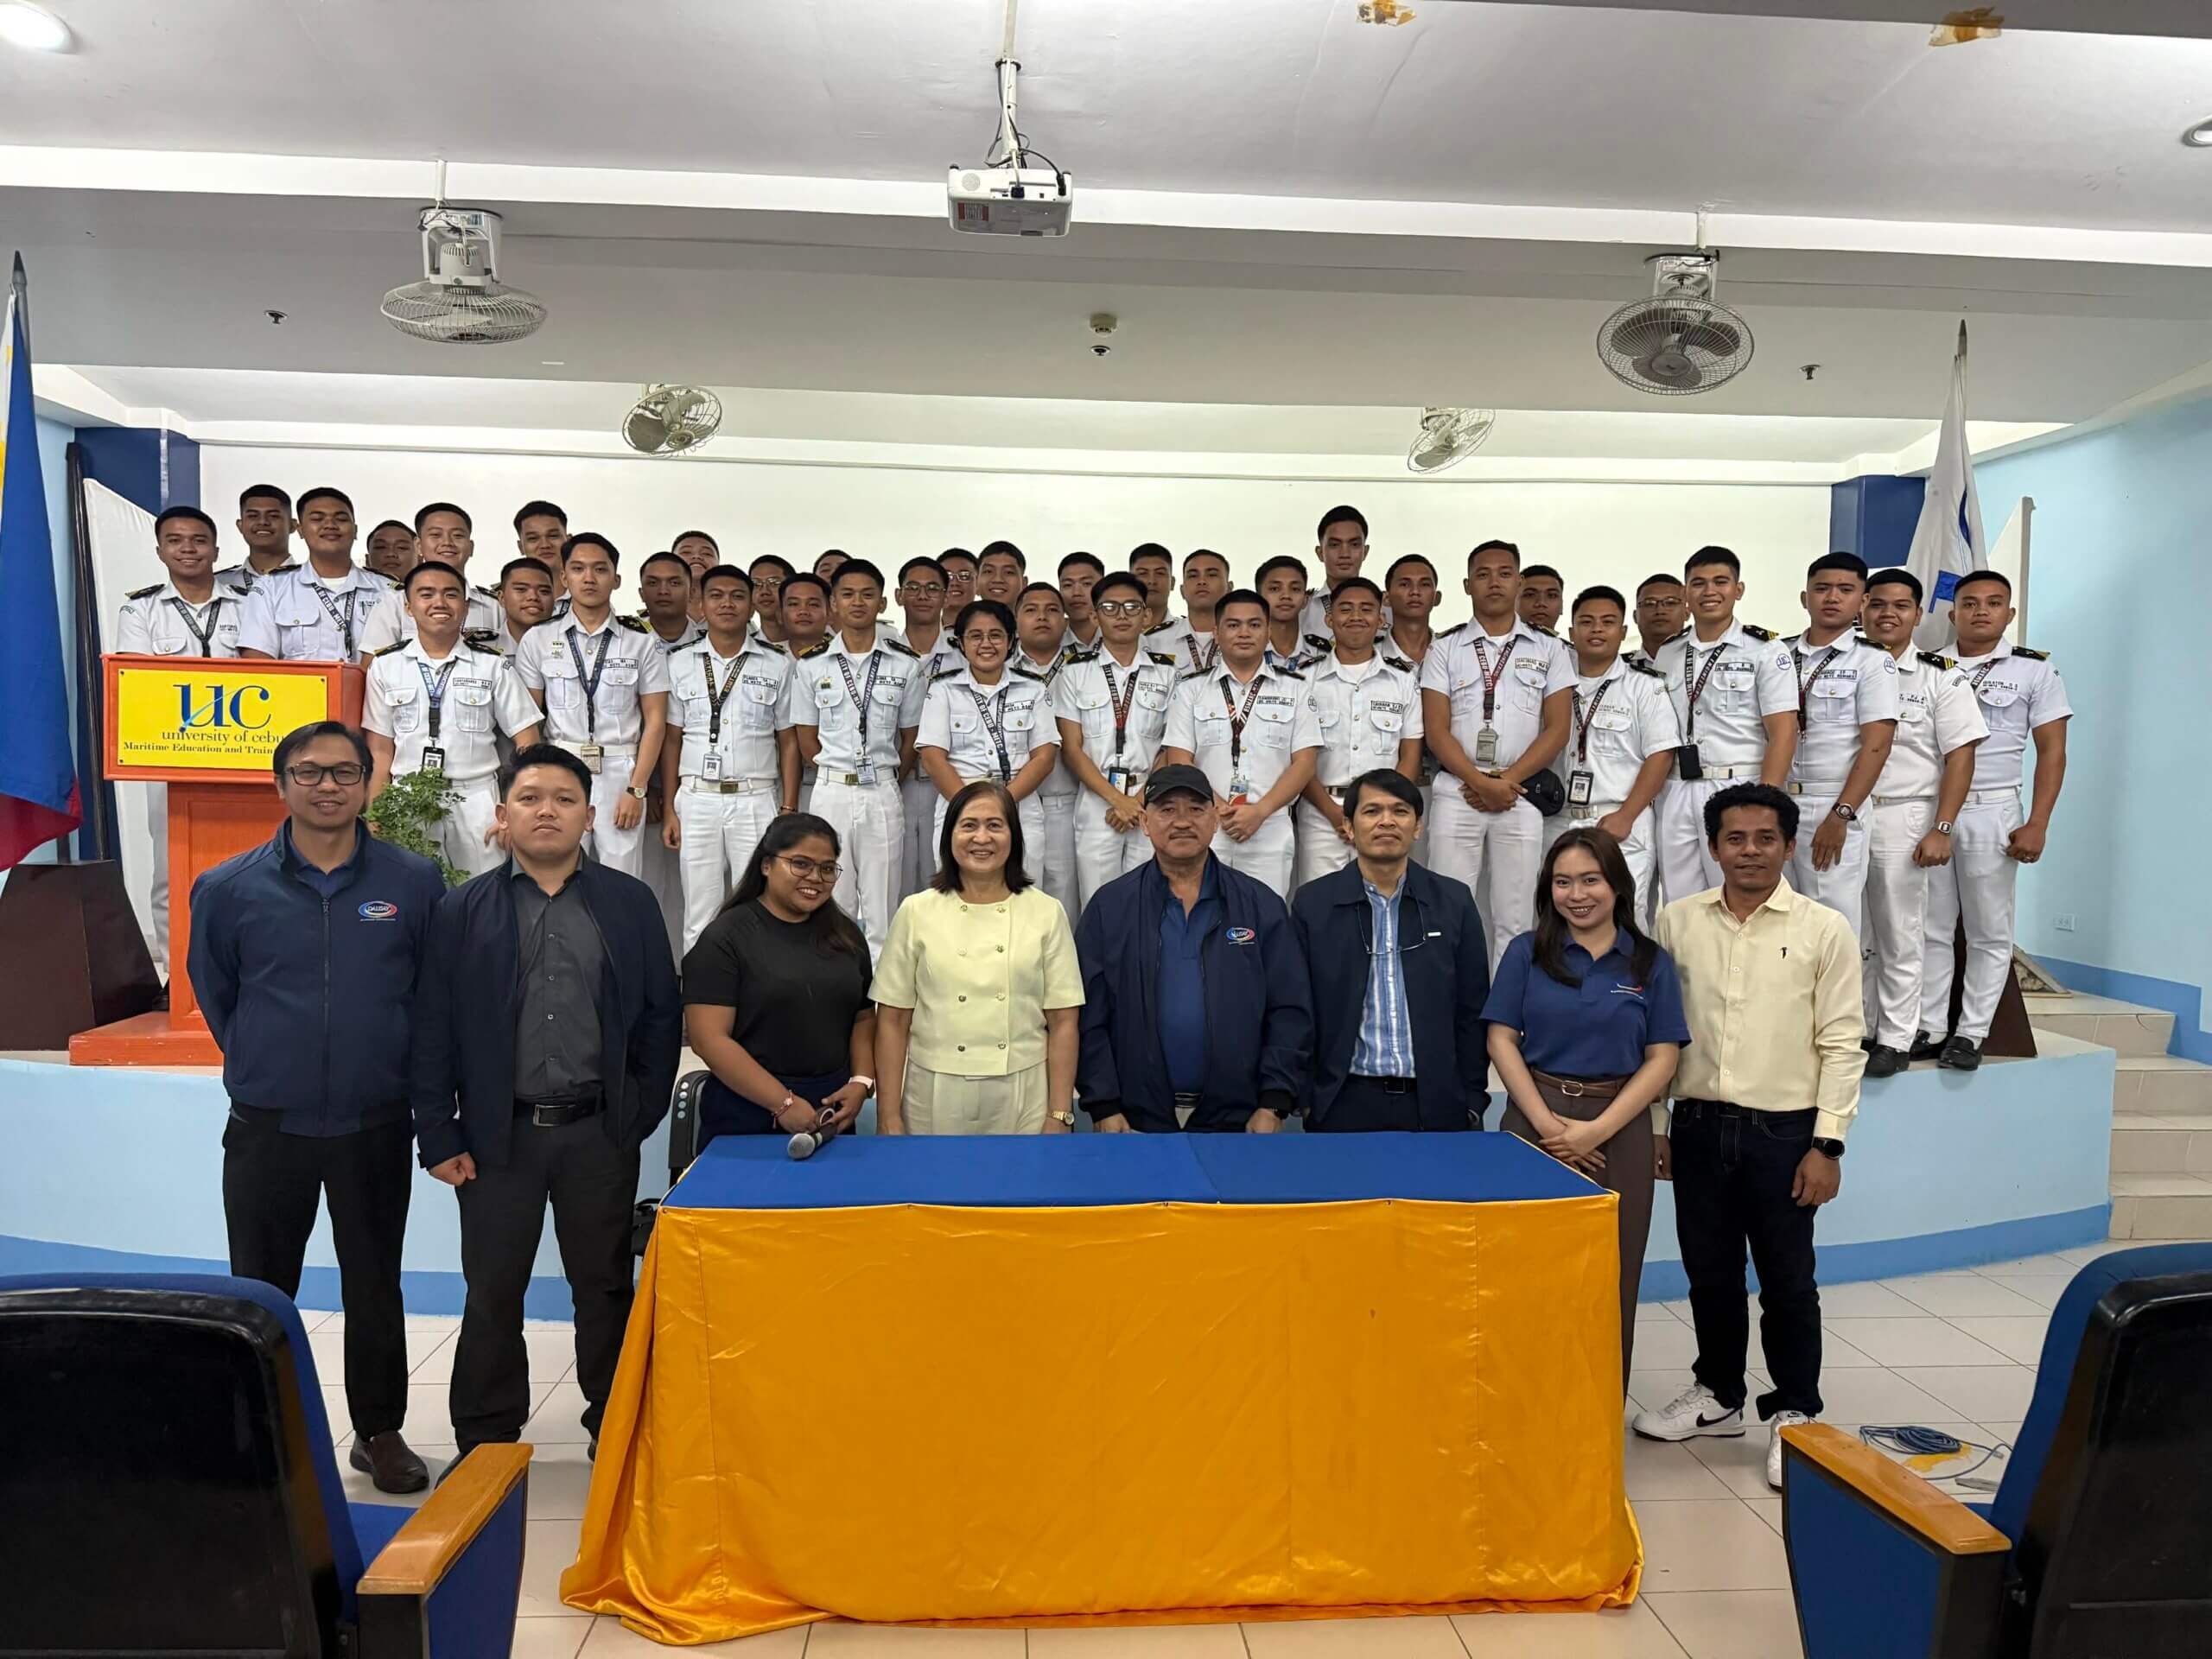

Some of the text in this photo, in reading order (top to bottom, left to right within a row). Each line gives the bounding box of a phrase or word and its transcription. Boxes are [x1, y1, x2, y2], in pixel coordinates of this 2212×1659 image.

[983, 712, 995, 729] CEBU
[161, 729, 230, 746] university
[234, 730, 249, 742] of
[124, 741, 169, 750] Maritime
[173, 743, 222, 752] Education
[245, 746, 273, 754] Train
